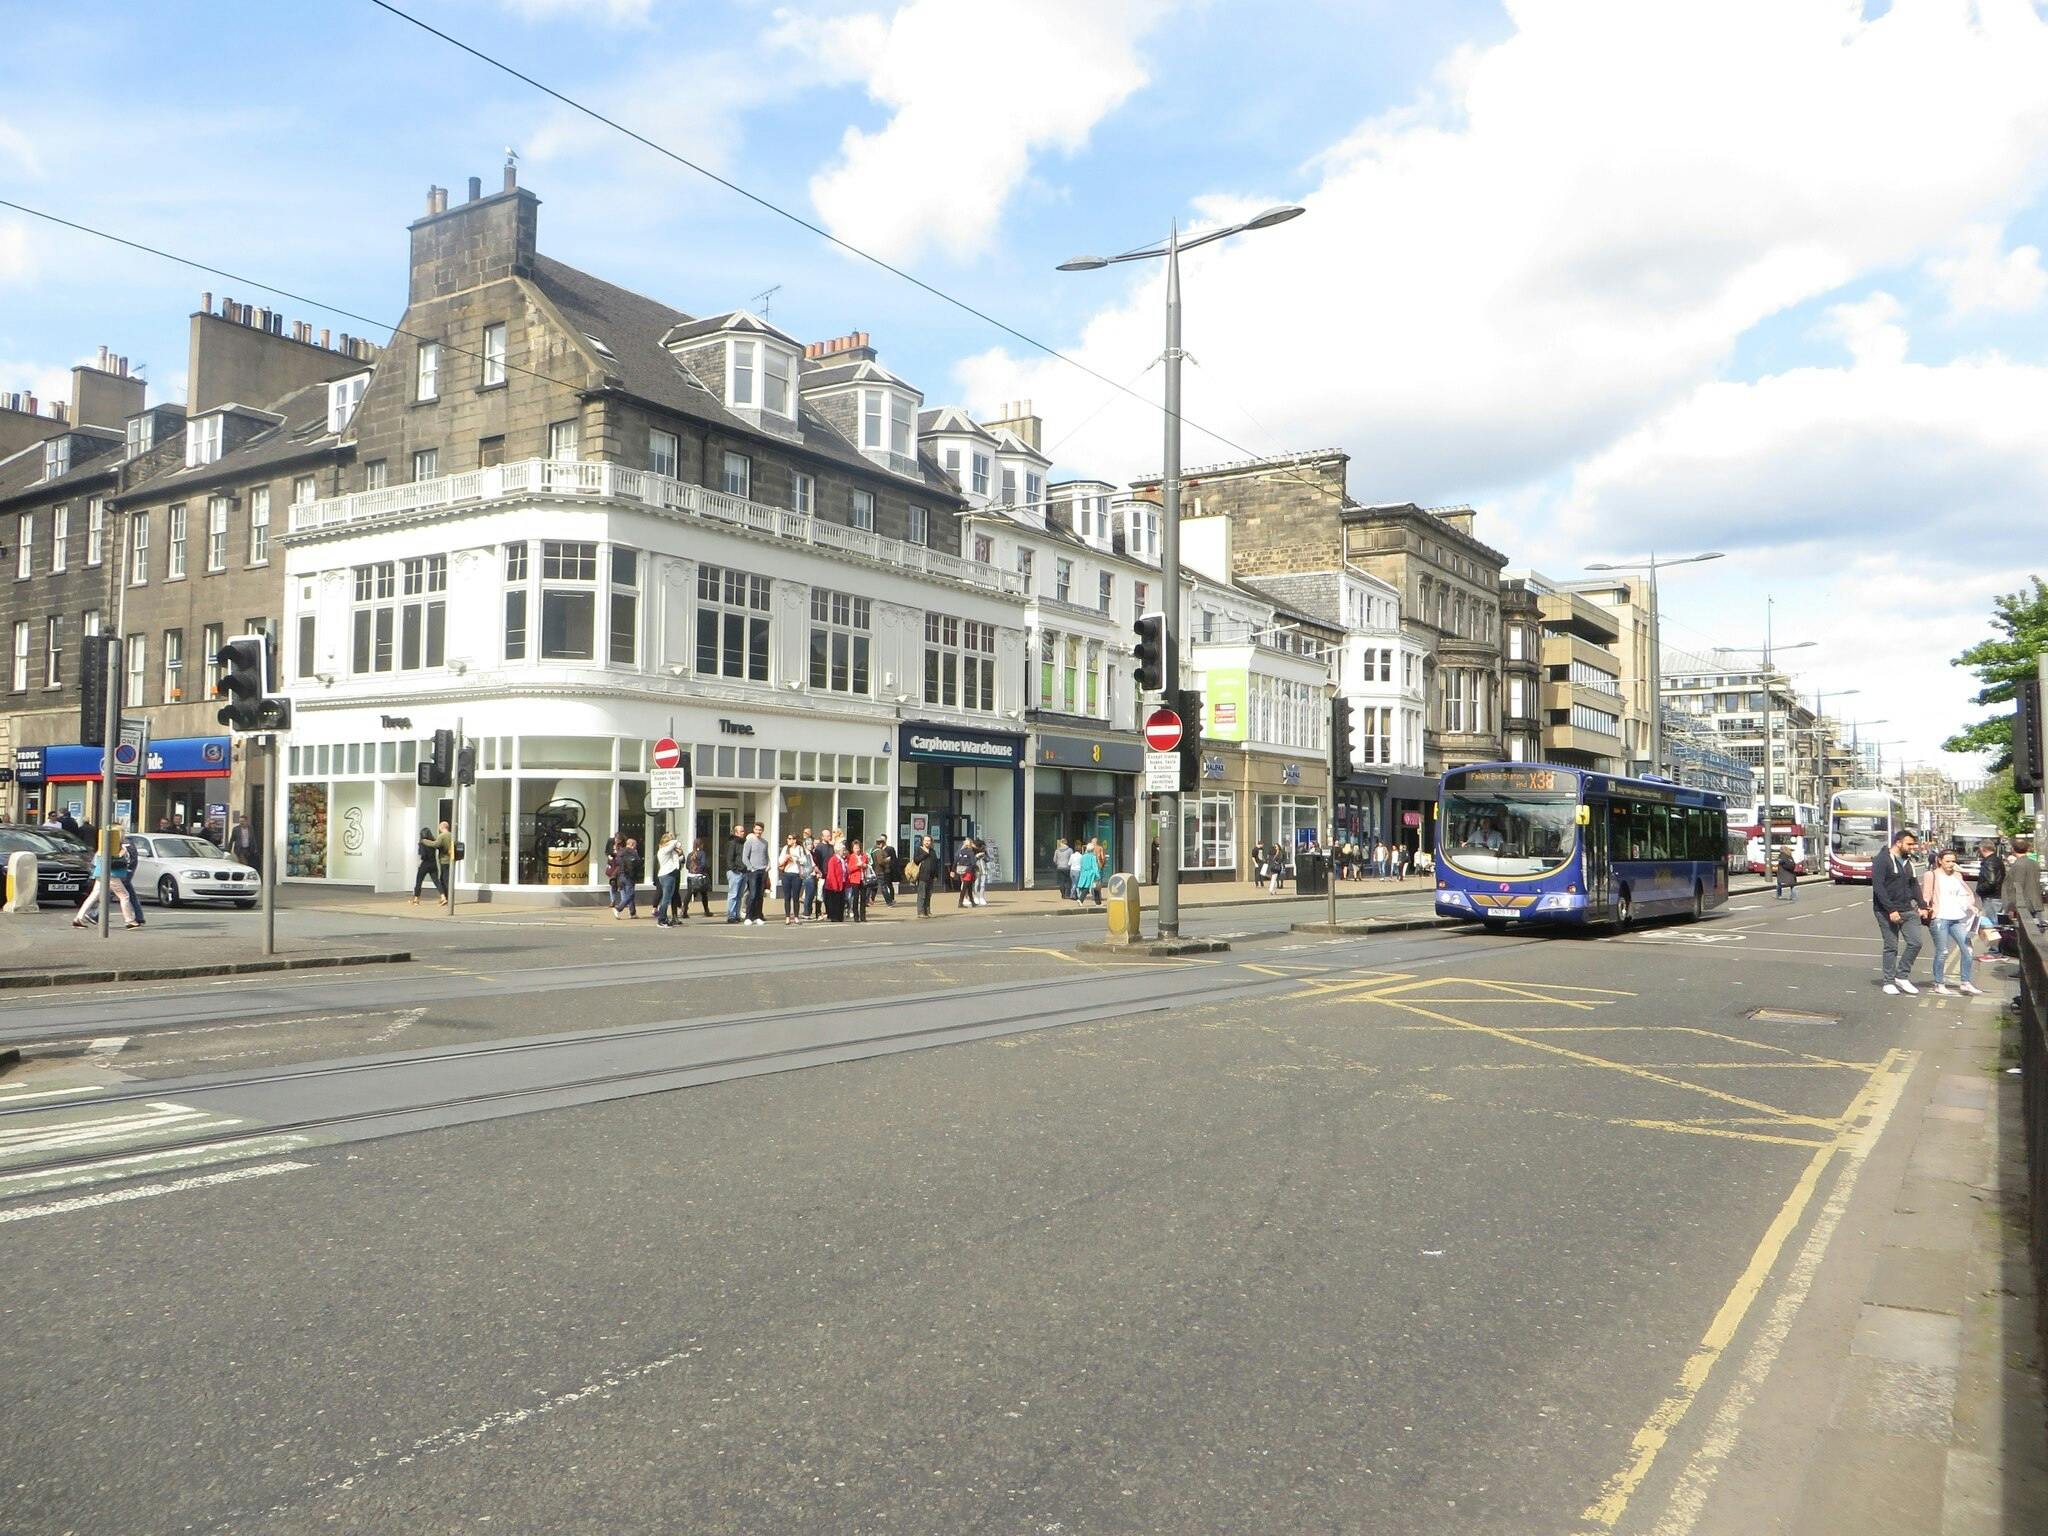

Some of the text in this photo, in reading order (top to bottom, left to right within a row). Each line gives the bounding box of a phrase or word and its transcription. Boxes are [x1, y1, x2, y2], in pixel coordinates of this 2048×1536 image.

[910, 735, 1013, 756] Carphone Warehouse
[1529, 772, 1554, 789] X38
